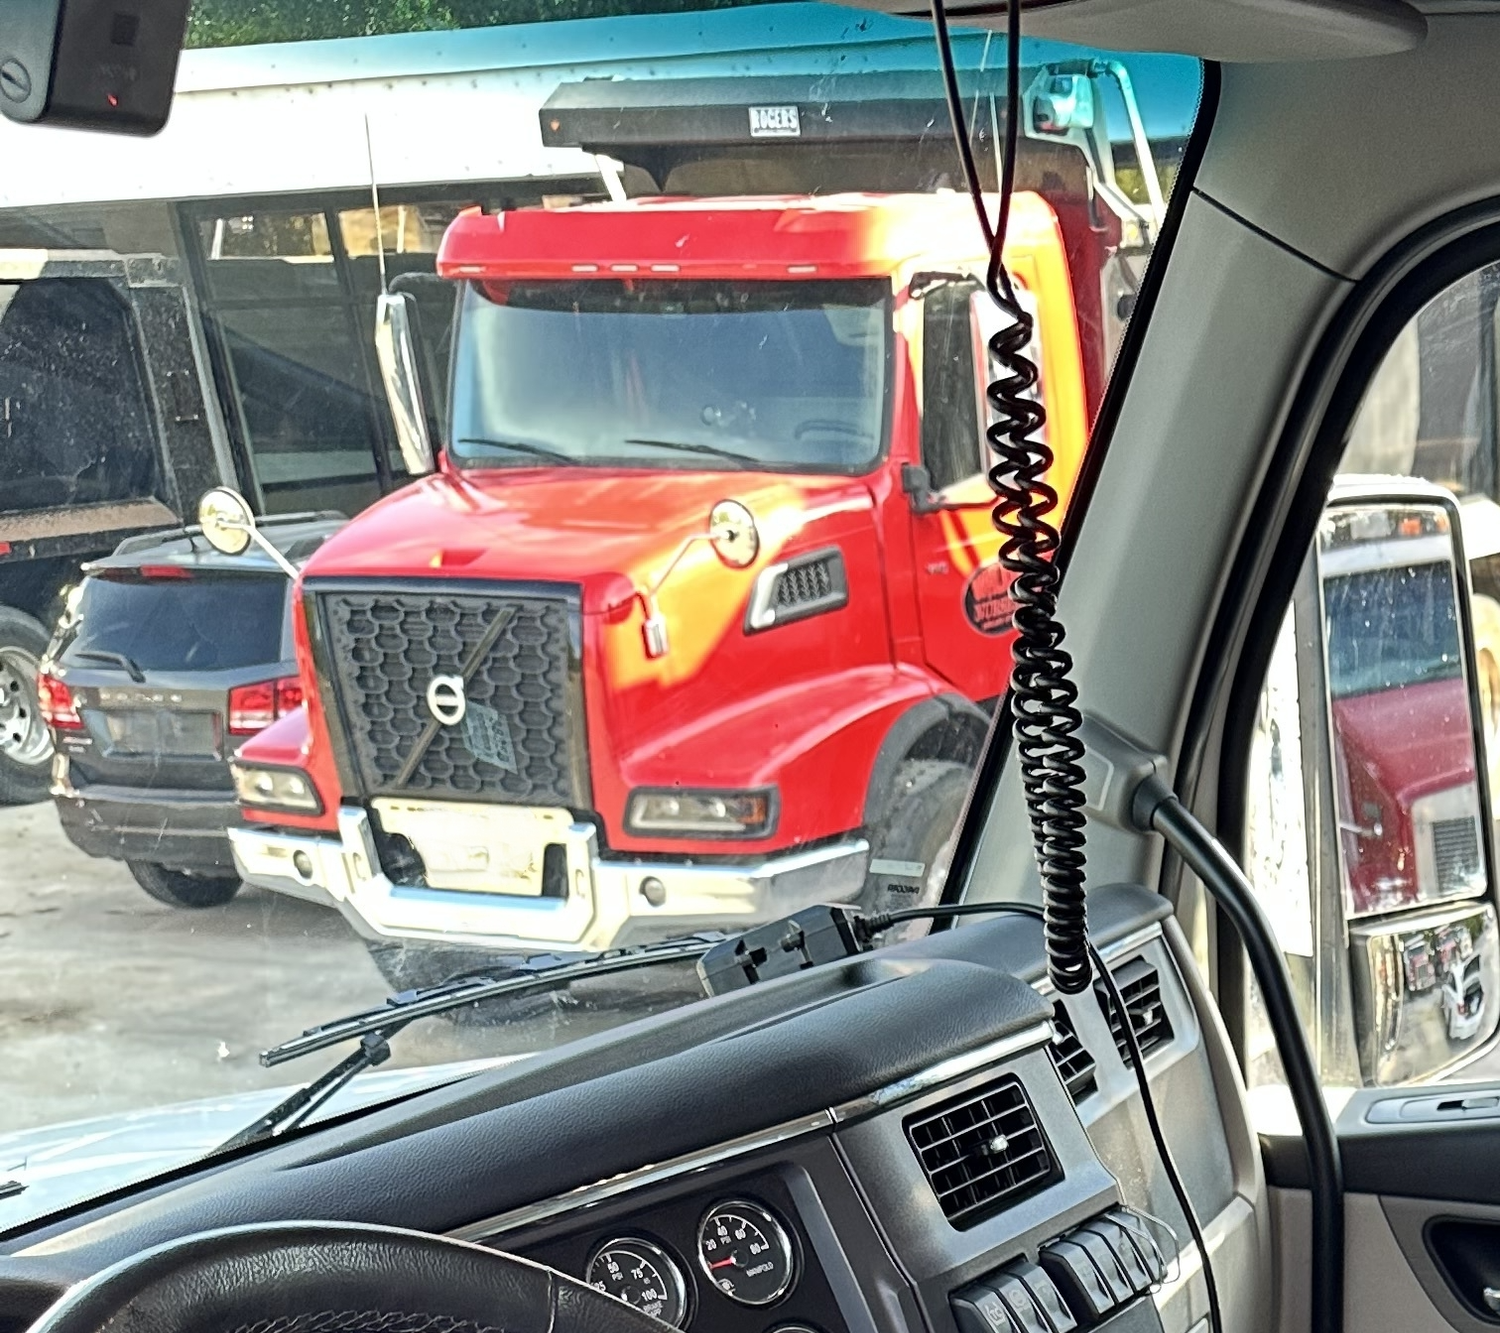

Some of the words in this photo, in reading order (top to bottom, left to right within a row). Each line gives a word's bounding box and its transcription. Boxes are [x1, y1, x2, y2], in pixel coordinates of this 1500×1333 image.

[750, 109, 798, 129] ROGERS
[631, 1267, 644, 1280] 75
[641, 1288, 658, 1302] 100
